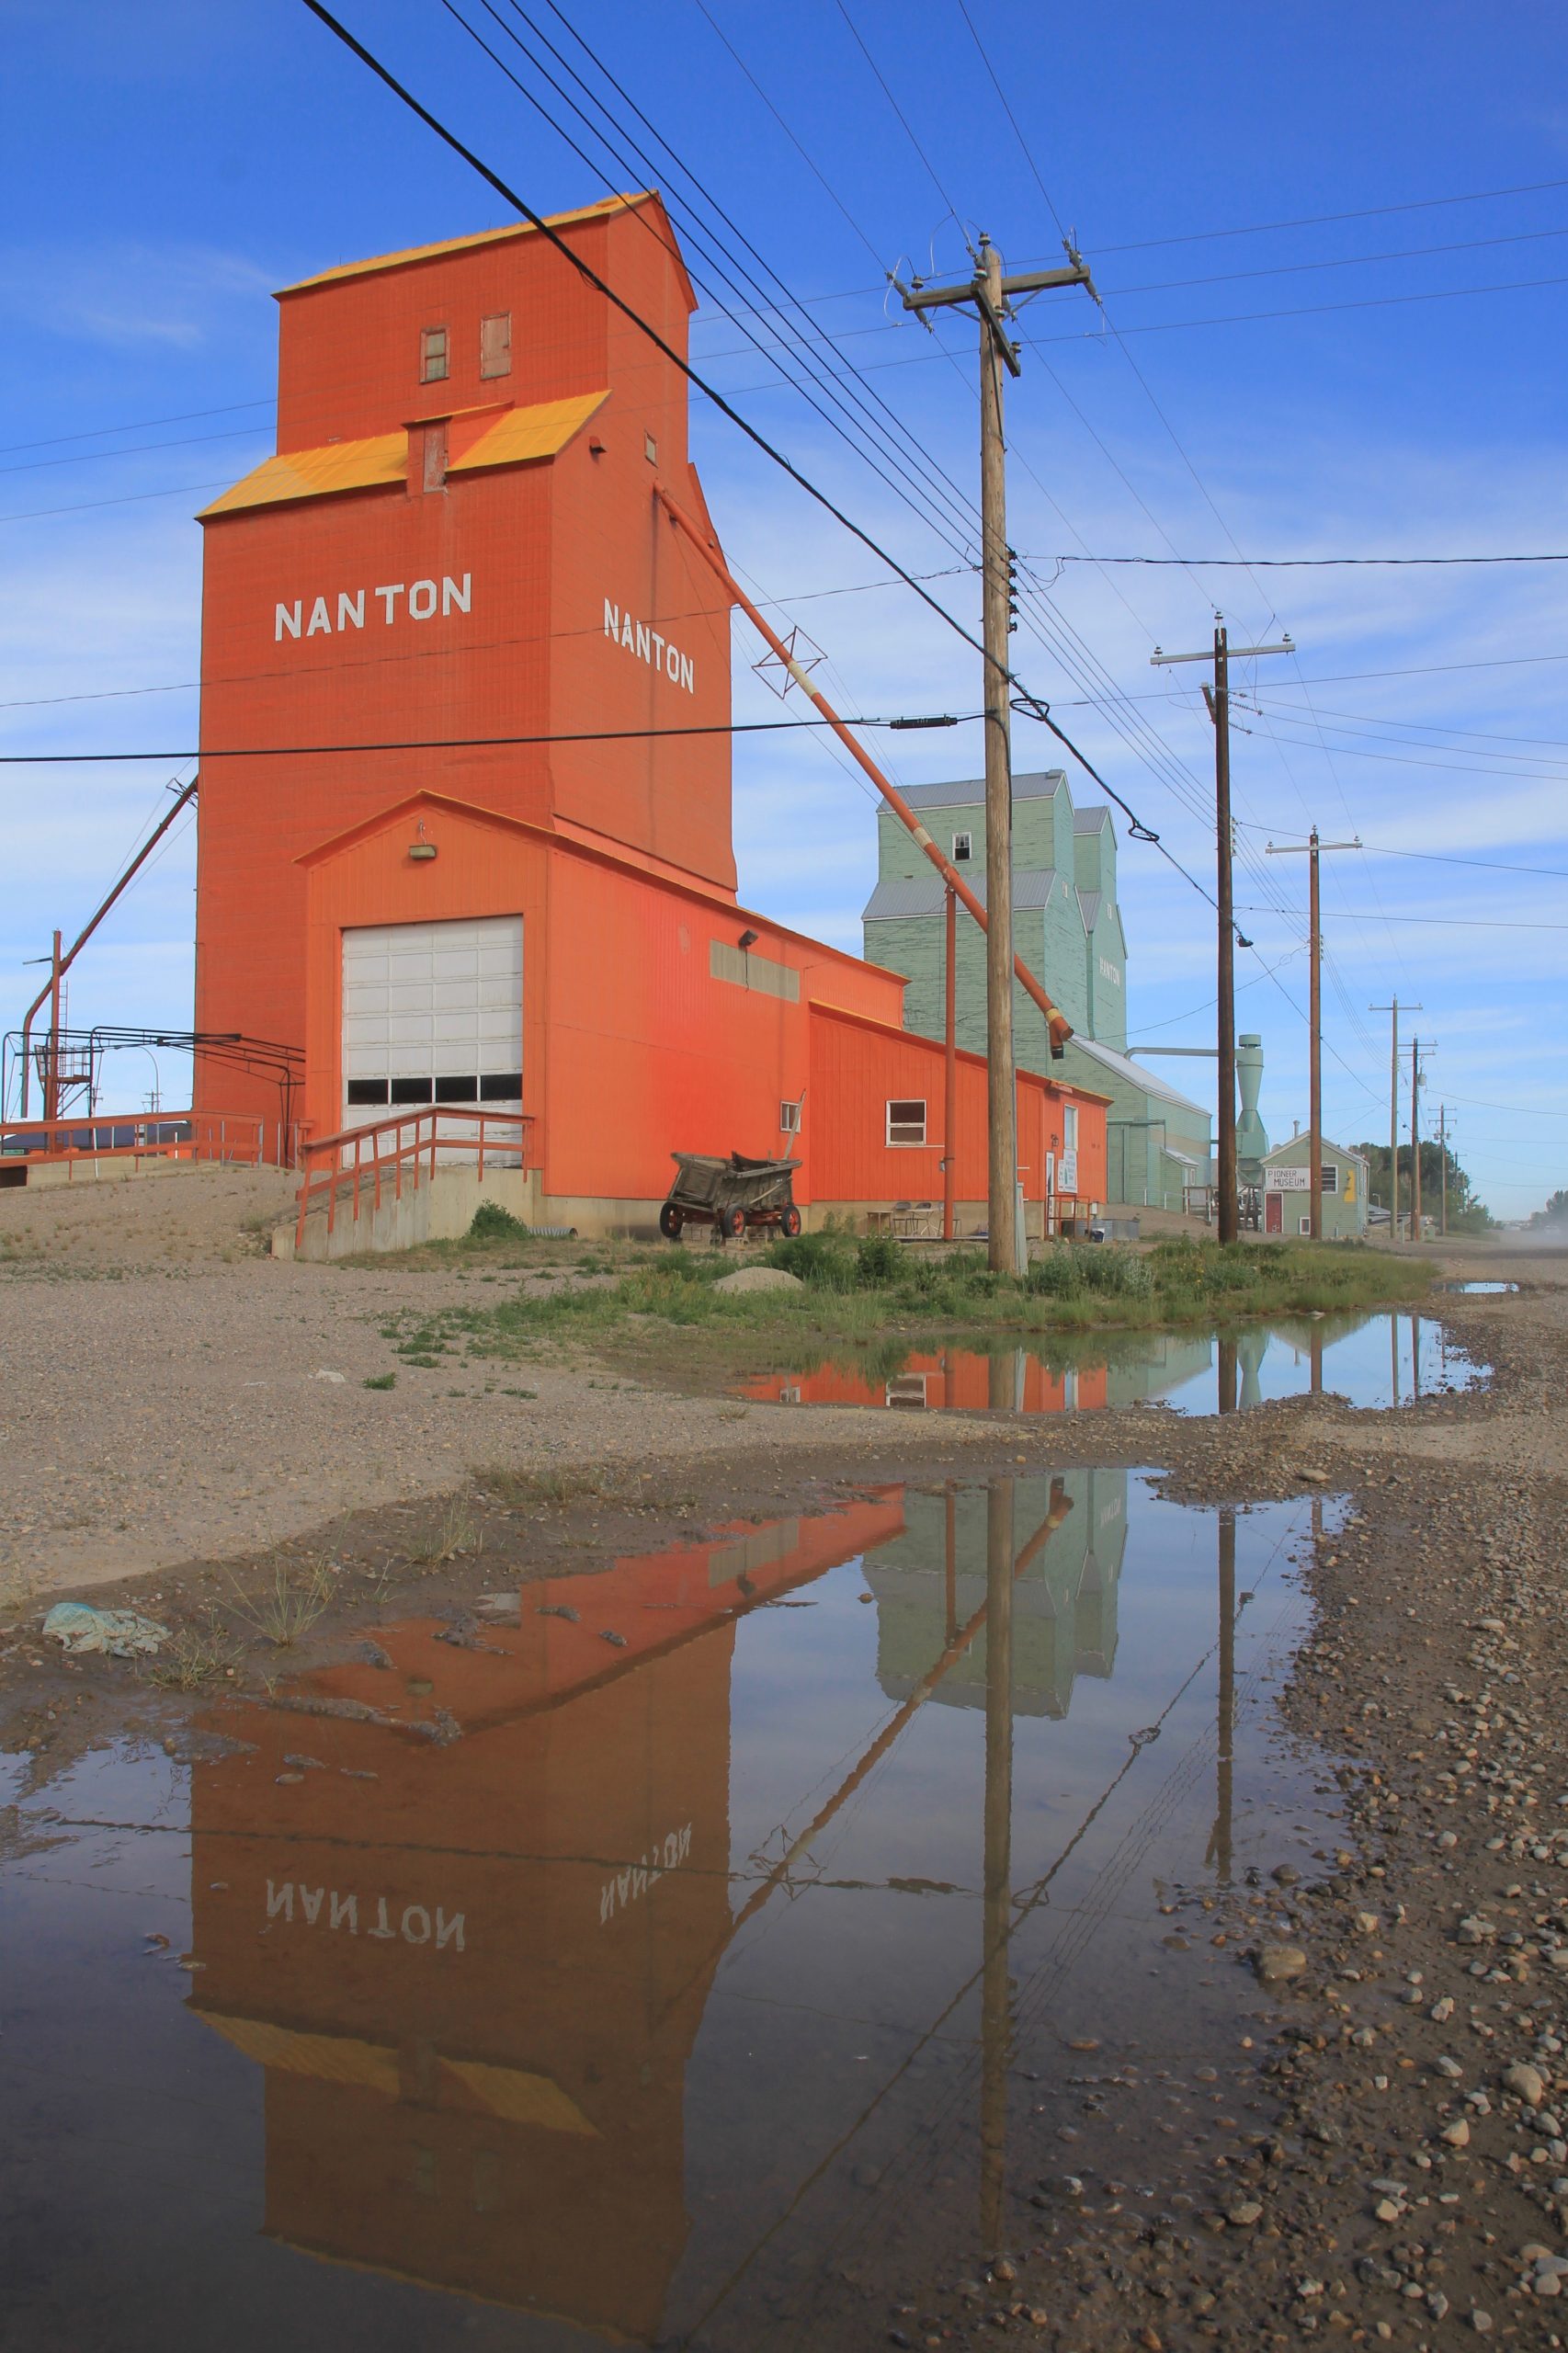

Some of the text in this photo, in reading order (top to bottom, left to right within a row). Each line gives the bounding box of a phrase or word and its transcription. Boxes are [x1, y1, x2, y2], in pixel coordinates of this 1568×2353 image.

[275, 573, 472, 642] NANTON
[604, 597, 695, 694] NANTON
[1274, 1177, 1305, 1187] MUSEUM
